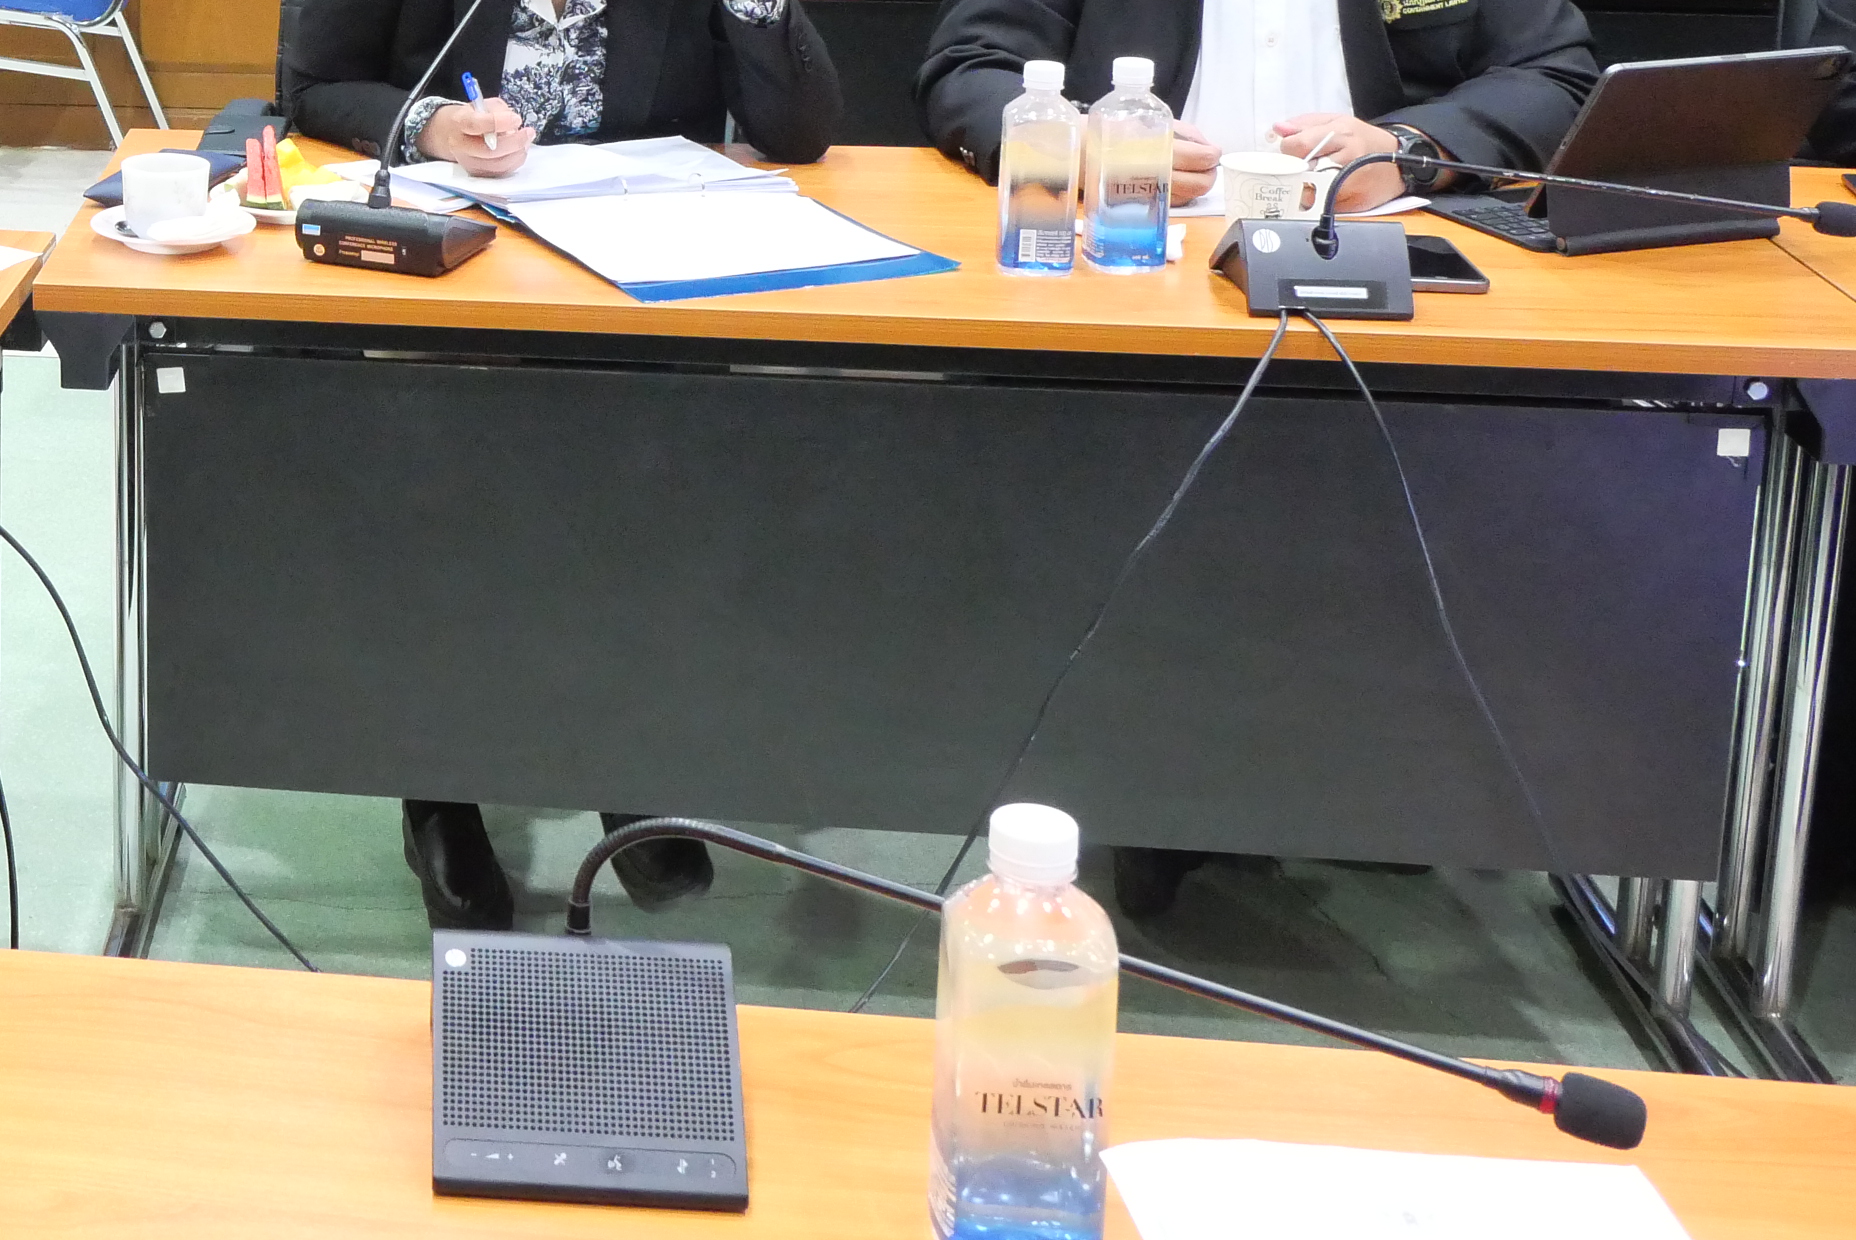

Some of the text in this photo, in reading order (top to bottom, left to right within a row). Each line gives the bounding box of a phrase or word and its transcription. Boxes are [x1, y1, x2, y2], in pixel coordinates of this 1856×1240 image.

[1113, 182, 1169, 194] TELSTAR
[1259, 186, 1291, 195] Coffee
[1255, 192, 1283, 202] Break
[974, 1091, 1104, 1119] TELSTAR
